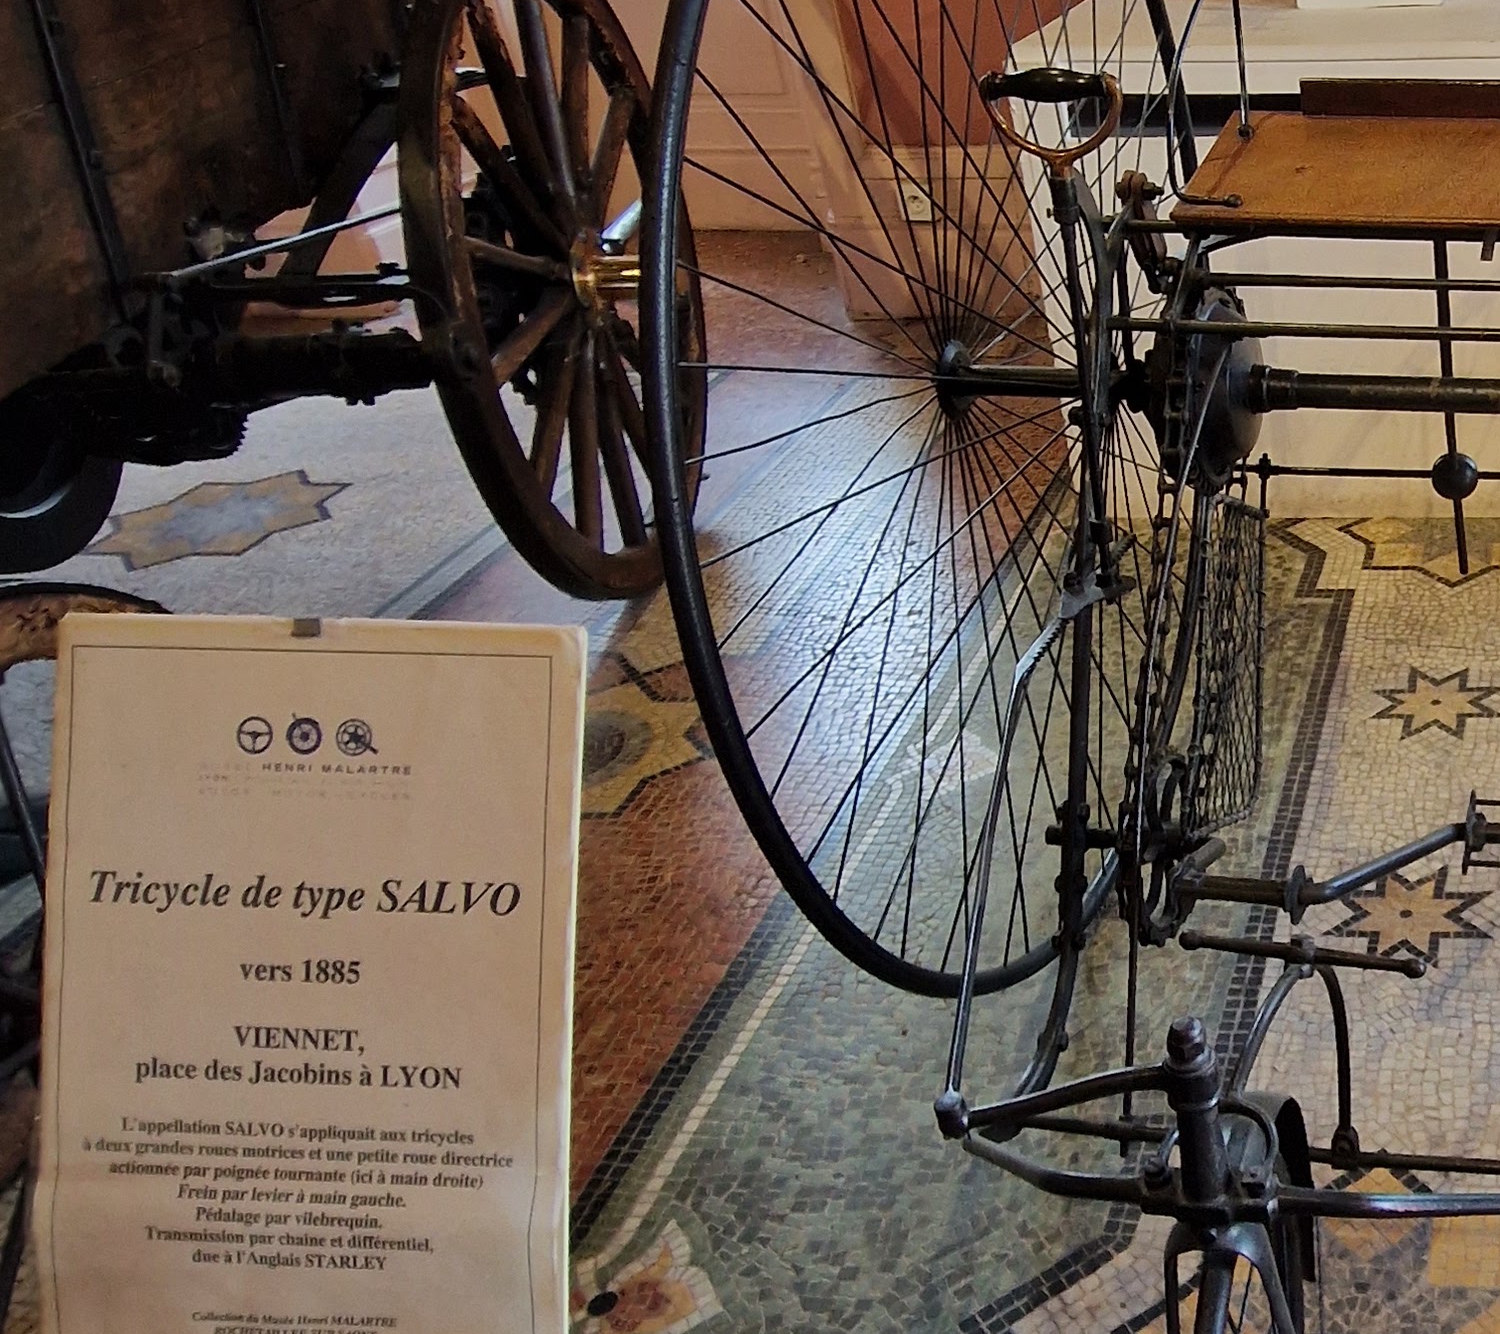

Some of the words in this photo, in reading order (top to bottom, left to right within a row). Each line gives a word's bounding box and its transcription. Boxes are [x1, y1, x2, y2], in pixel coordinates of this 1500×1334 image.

[262, 763, 312, 772] HENRI
[321, 764, 411, 776] MALARTRE
[89, 870, 231, 913] Tricycle
[241, 874, 282, 908] de
[292, 879, 365, 919] type
[376, 878, 521, 917] SALVO
[239, 962, 293, 983] vers
[300, 959, 361, 984] 1885
[233, 1024, 365, 1056] VIENNET,
[135, 1056, 198, 1084] place
[204, 1059, 242, 1081] des
[248, 1060, 352, 1085] Jacobins
[359, 1064, 373, 1086] à
[380, 1065, 463, 1089] LYON
[121, 1117, 221, 1136] L'appellation
[225, 1121, 284, 1138] SALVO
[288, 1124, 376, 1144] s'appliquait
[380, 1131, 406, 1142] aux
[411, 1129, 474, 1147] tricycles
[95, 1137, 132, 1153] deux
[135, 1140, 194, 1156] grandes
[199, 1145, 238, 1157] roues
[242, 1144, 305, 1160] motrices
[309, 1148, 322, 1160] et
[326, 1150, 352, 1161] une
[357, 1148, 399, 1165] petite
[403, 1153, 437, 1165] roue
[441, 1151, 514, 1168] directrice
[183, 1165, 211, 1179] par
[213, 1164, 270, 1181] poignée
[273, 1166, 347, 1182] tournante
[351, 1168, 373, 1186] (ici
[377, 1169, 386, 1184] à
[390, 1171, 428, 1186] main
[433, 1172, 484, 1190] droite)
[176, 1183, 218, 1200] Frein
[221, 1187, 248, 1204] par
[251, 1186, 295, 1203] levier
[296, 1188, 305, 1203] à
[309, 1190, 347, 1205] main
[349, 1192, 407, 1209] gauche.
[195, 1206, 261, 1225] Pédalage
[264, 1213, 292, 1227] par
[294, 1211, 383, 1231] vilebrequin.
[144, 1225, 245, 1244] Transmission
[250, 1234, 275, 1248] par
[330, 1234, 344, 1248] et
[347, 1234, 434, 1254] différentiel,
[192, 1249, 220, 1263] due
[224, 1250, 233, 1263] à
[236, 1250, 301, 1269] l'Anglais
[304, 1253, 388, 1270] STARLEY
[330, 1315, 398, 1328] MALARTRE
